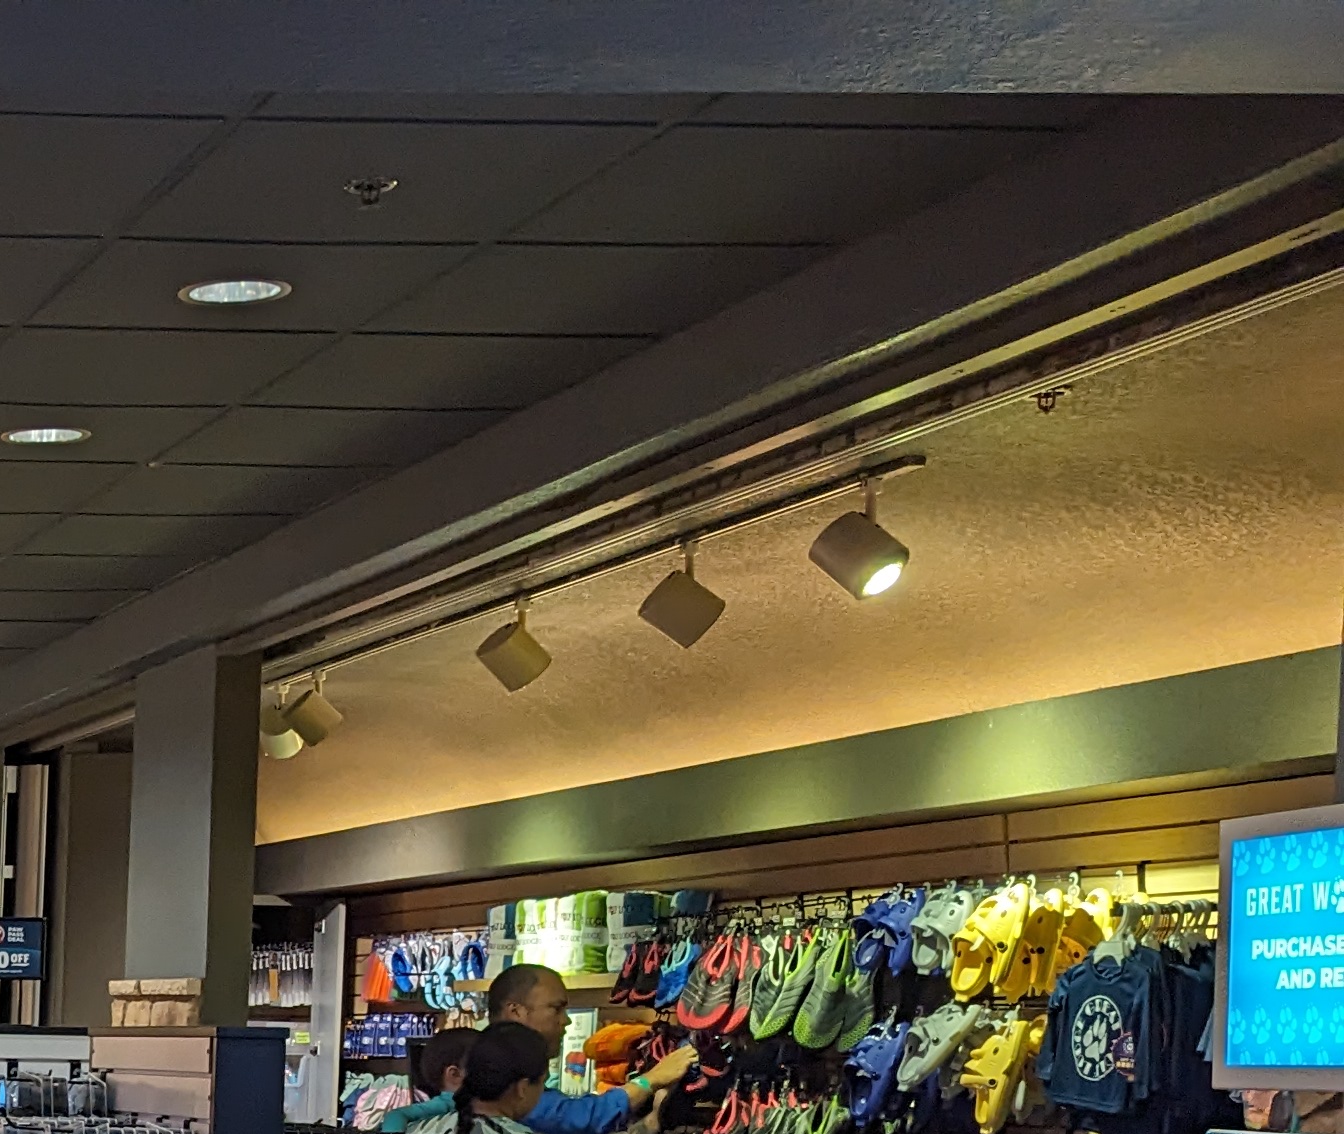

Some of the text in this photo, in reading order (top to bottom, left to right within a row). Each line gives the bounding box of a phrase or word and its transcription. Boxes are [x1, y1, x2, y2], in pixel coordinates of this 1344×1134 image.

[1246, 882, 1305, 917] GREAT
[11, 953, 30, 963] OFF
[1251, 934, 1344, 960] PURCHASE
[1275, 966, 1344, 990] AND RE
